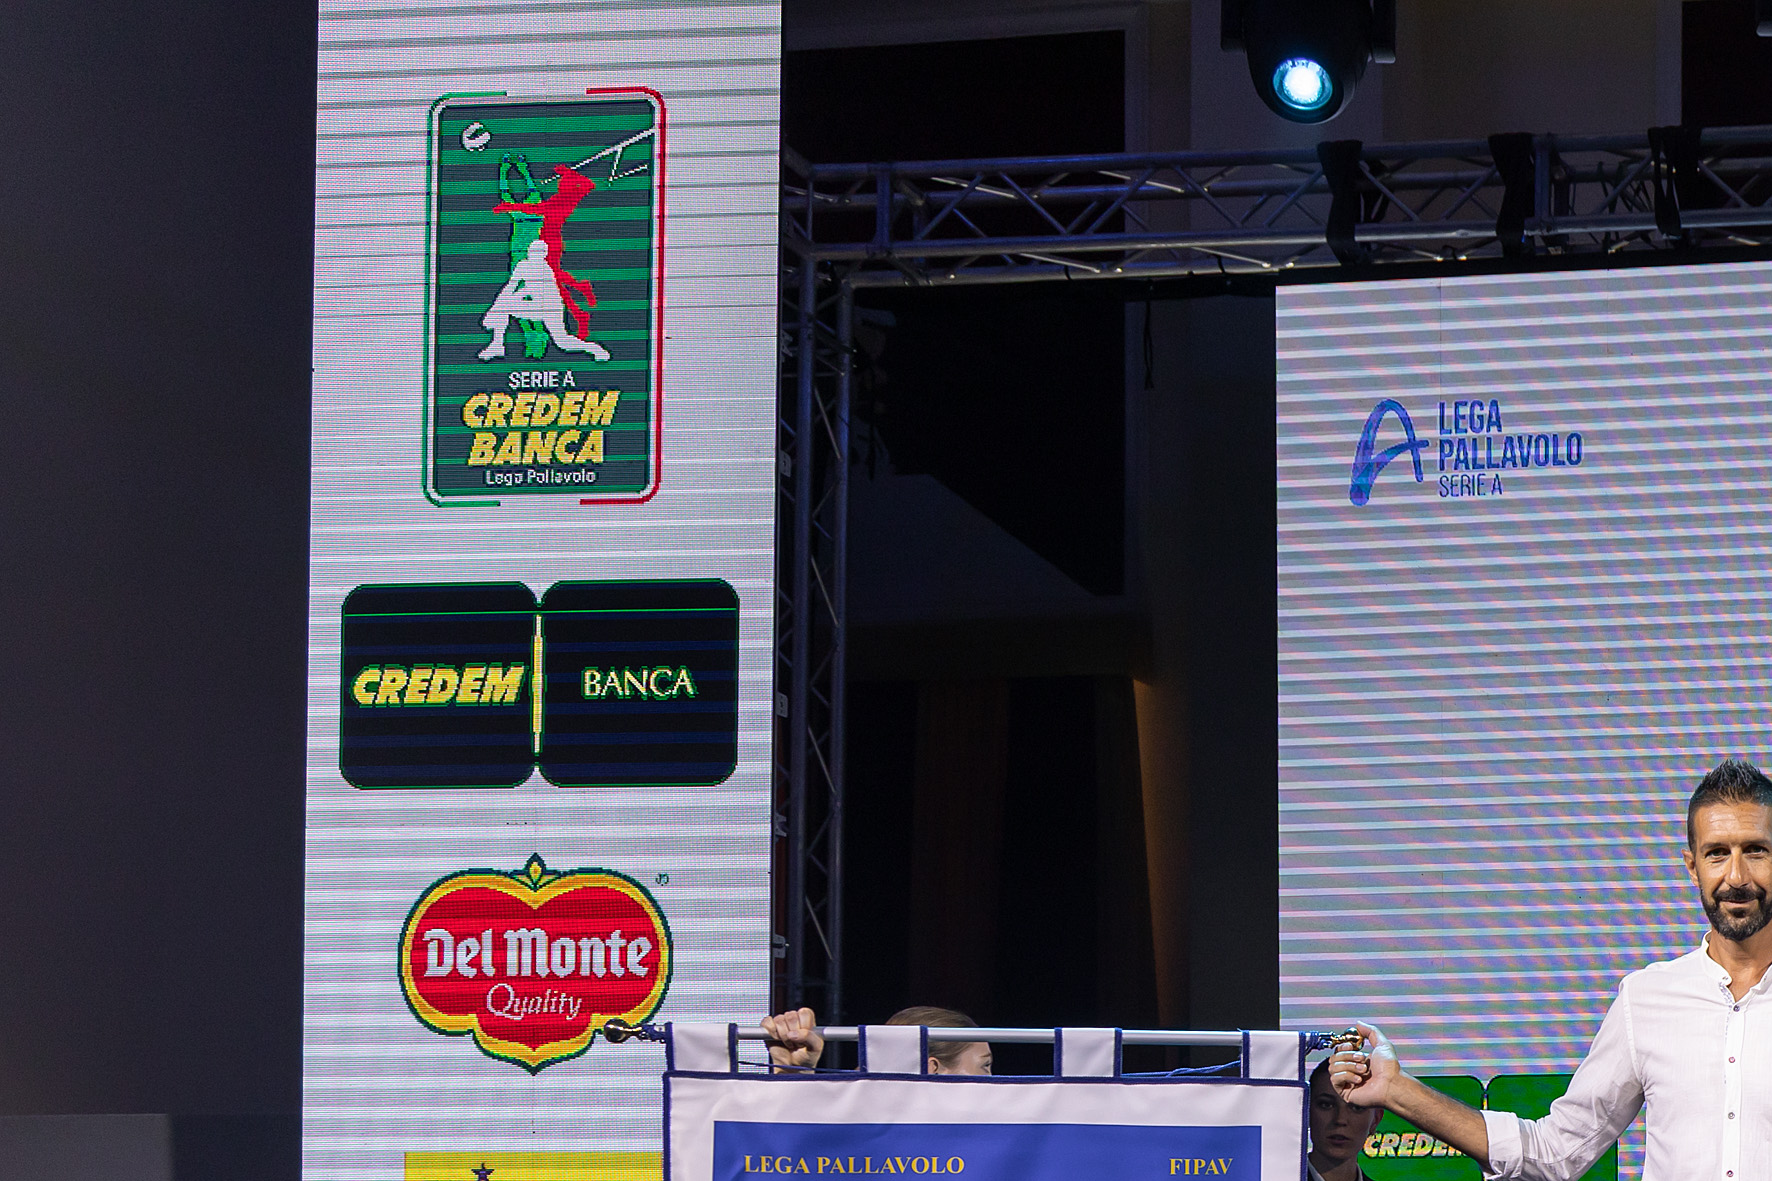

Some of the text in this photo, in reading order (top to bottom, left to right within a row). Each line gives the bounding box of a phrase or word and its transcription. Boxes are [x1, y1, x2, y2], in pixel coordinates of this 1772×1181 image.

[508, 371, 575, 388] SERIE A
[461, 391, 620, 428] CREDEM
[1439, 399, 1503, 435] LEGA
[468, 430, 604, 466] BANCA
[1439, 432, 1583, 471] PALLAVOLO
[485, 469, 596, 486] Lega Pallavolo
[1439, 473, 1503, 497] SERIE A
[352, 664, 696, 706] CREDEM BANCA
[422, 927, 653, 979] Del Monte
[487, 984, 583, 1019] Quality
[744, 1155, 965, 1176] LEGA PALLAVOLO
[1169, 1158, 1234, 1176] FIPAV
